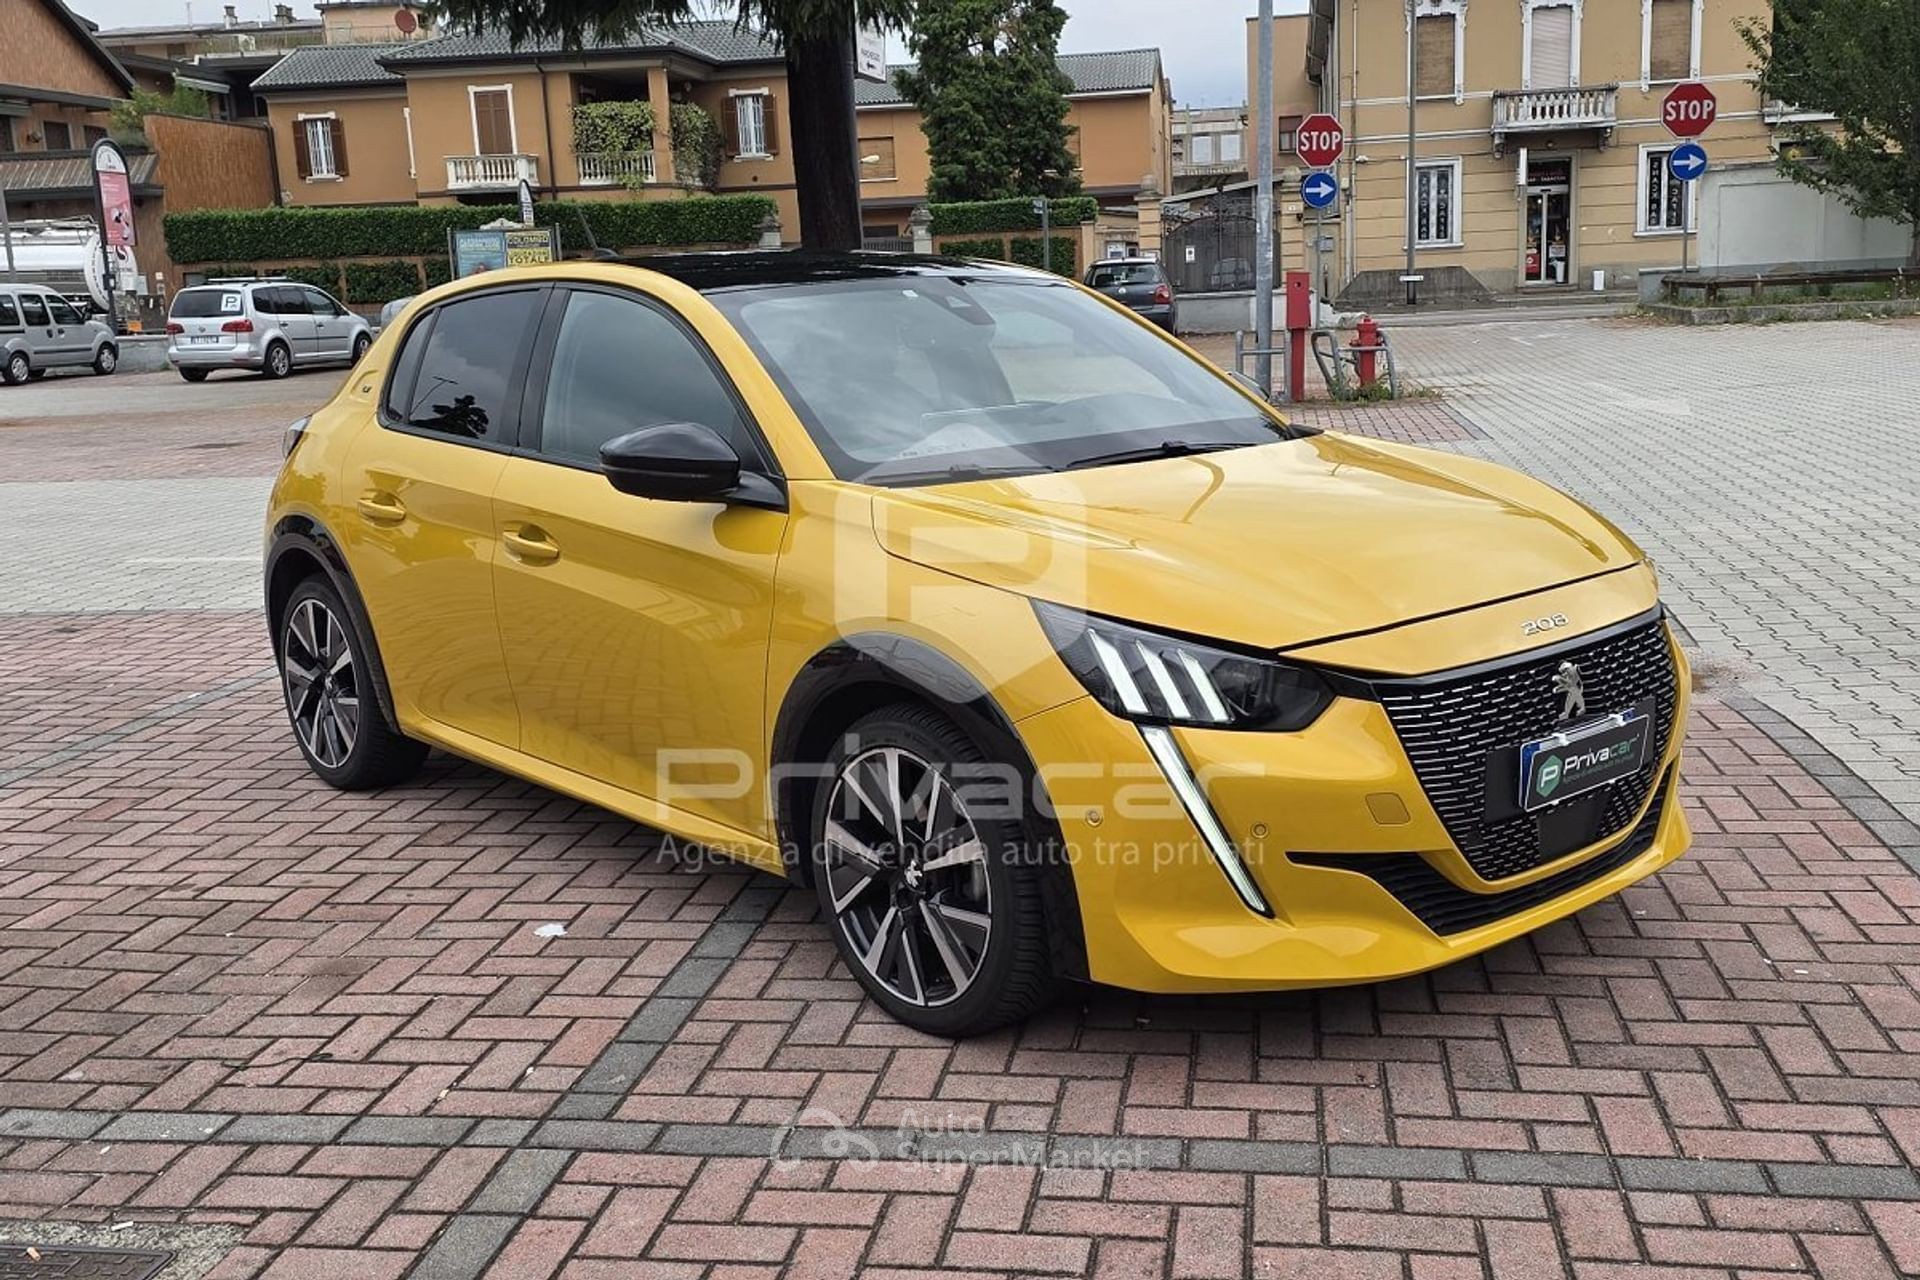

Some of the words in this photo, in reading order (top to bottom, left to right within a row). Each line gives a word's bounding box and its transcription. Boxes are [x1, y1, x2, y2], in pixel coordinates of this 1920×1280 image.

[1665, 100, 1714, 121] STOP
[1300, 131, 1341, 151] STOP
[225, 295, 238, 308] P
[1520, 612, 1570, 636] 208
[1563, 738, 1638, 776] Privacar
